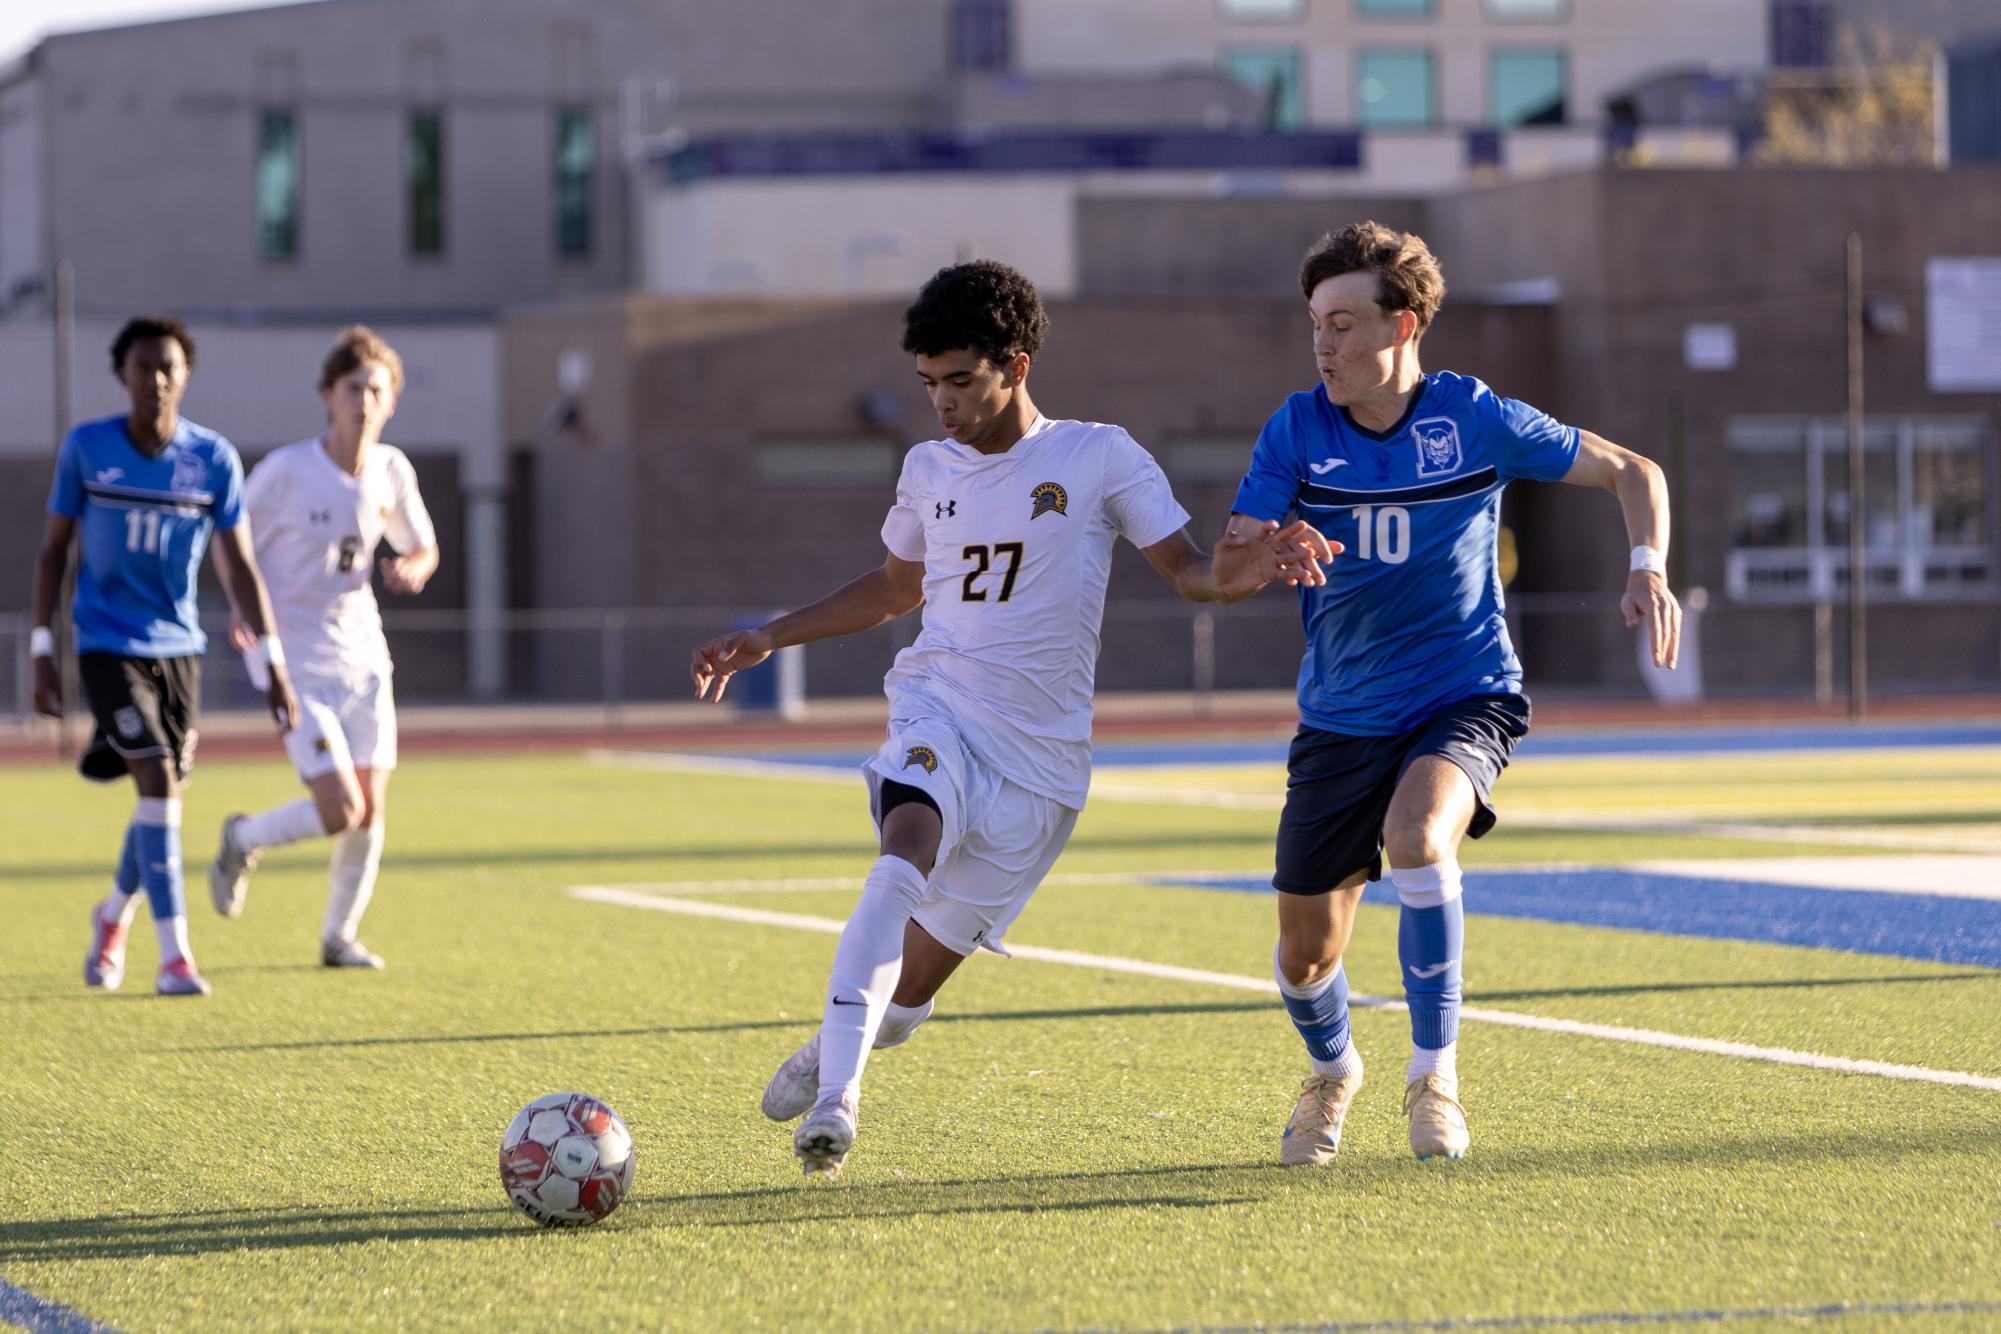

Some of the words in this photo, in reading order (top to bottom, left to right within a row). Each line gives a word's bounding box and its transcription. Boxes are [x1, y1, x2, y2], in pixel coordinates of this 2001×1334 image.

[125, 508, 160, 554] 11
[1352, 505, 1411, 565] 10
[960, 541, 1024, 605] 27
